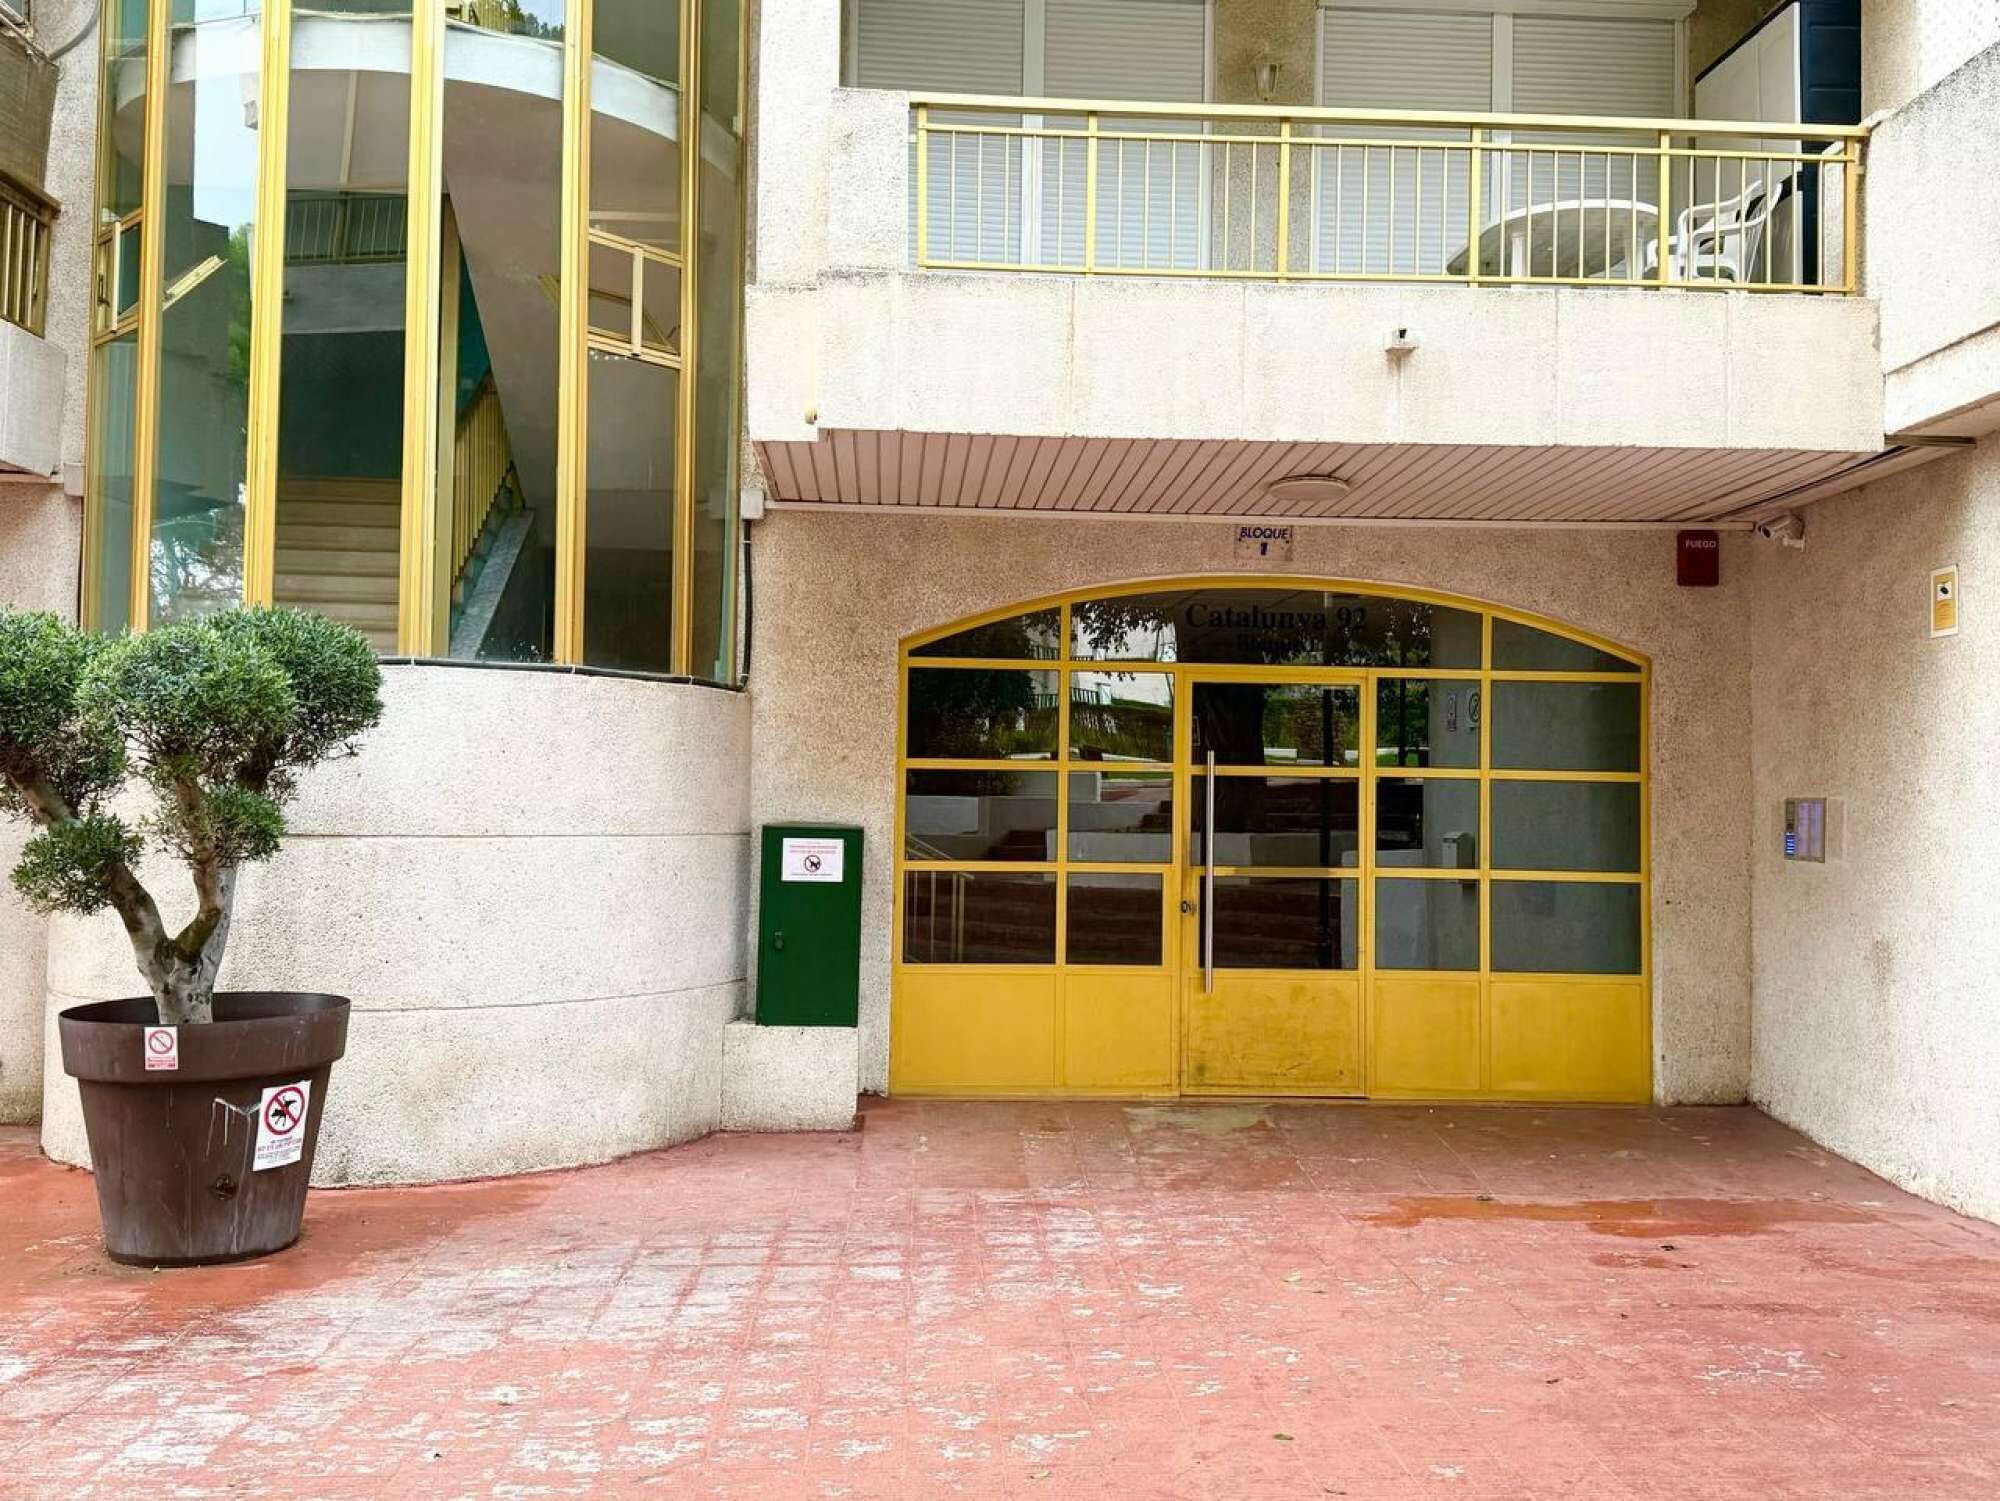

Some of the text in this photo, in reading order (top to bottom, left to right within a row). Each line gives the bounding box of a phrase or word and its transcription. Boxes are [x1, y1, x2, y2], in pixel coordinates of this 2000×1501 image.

[1240, 526, 1289, 539] BLOQUE
[1260, 542, 1268, 556] 1
[1685, 540, 1717, 549] FUEGO
[1185, 602, 1368, 633] Catalunya 92
